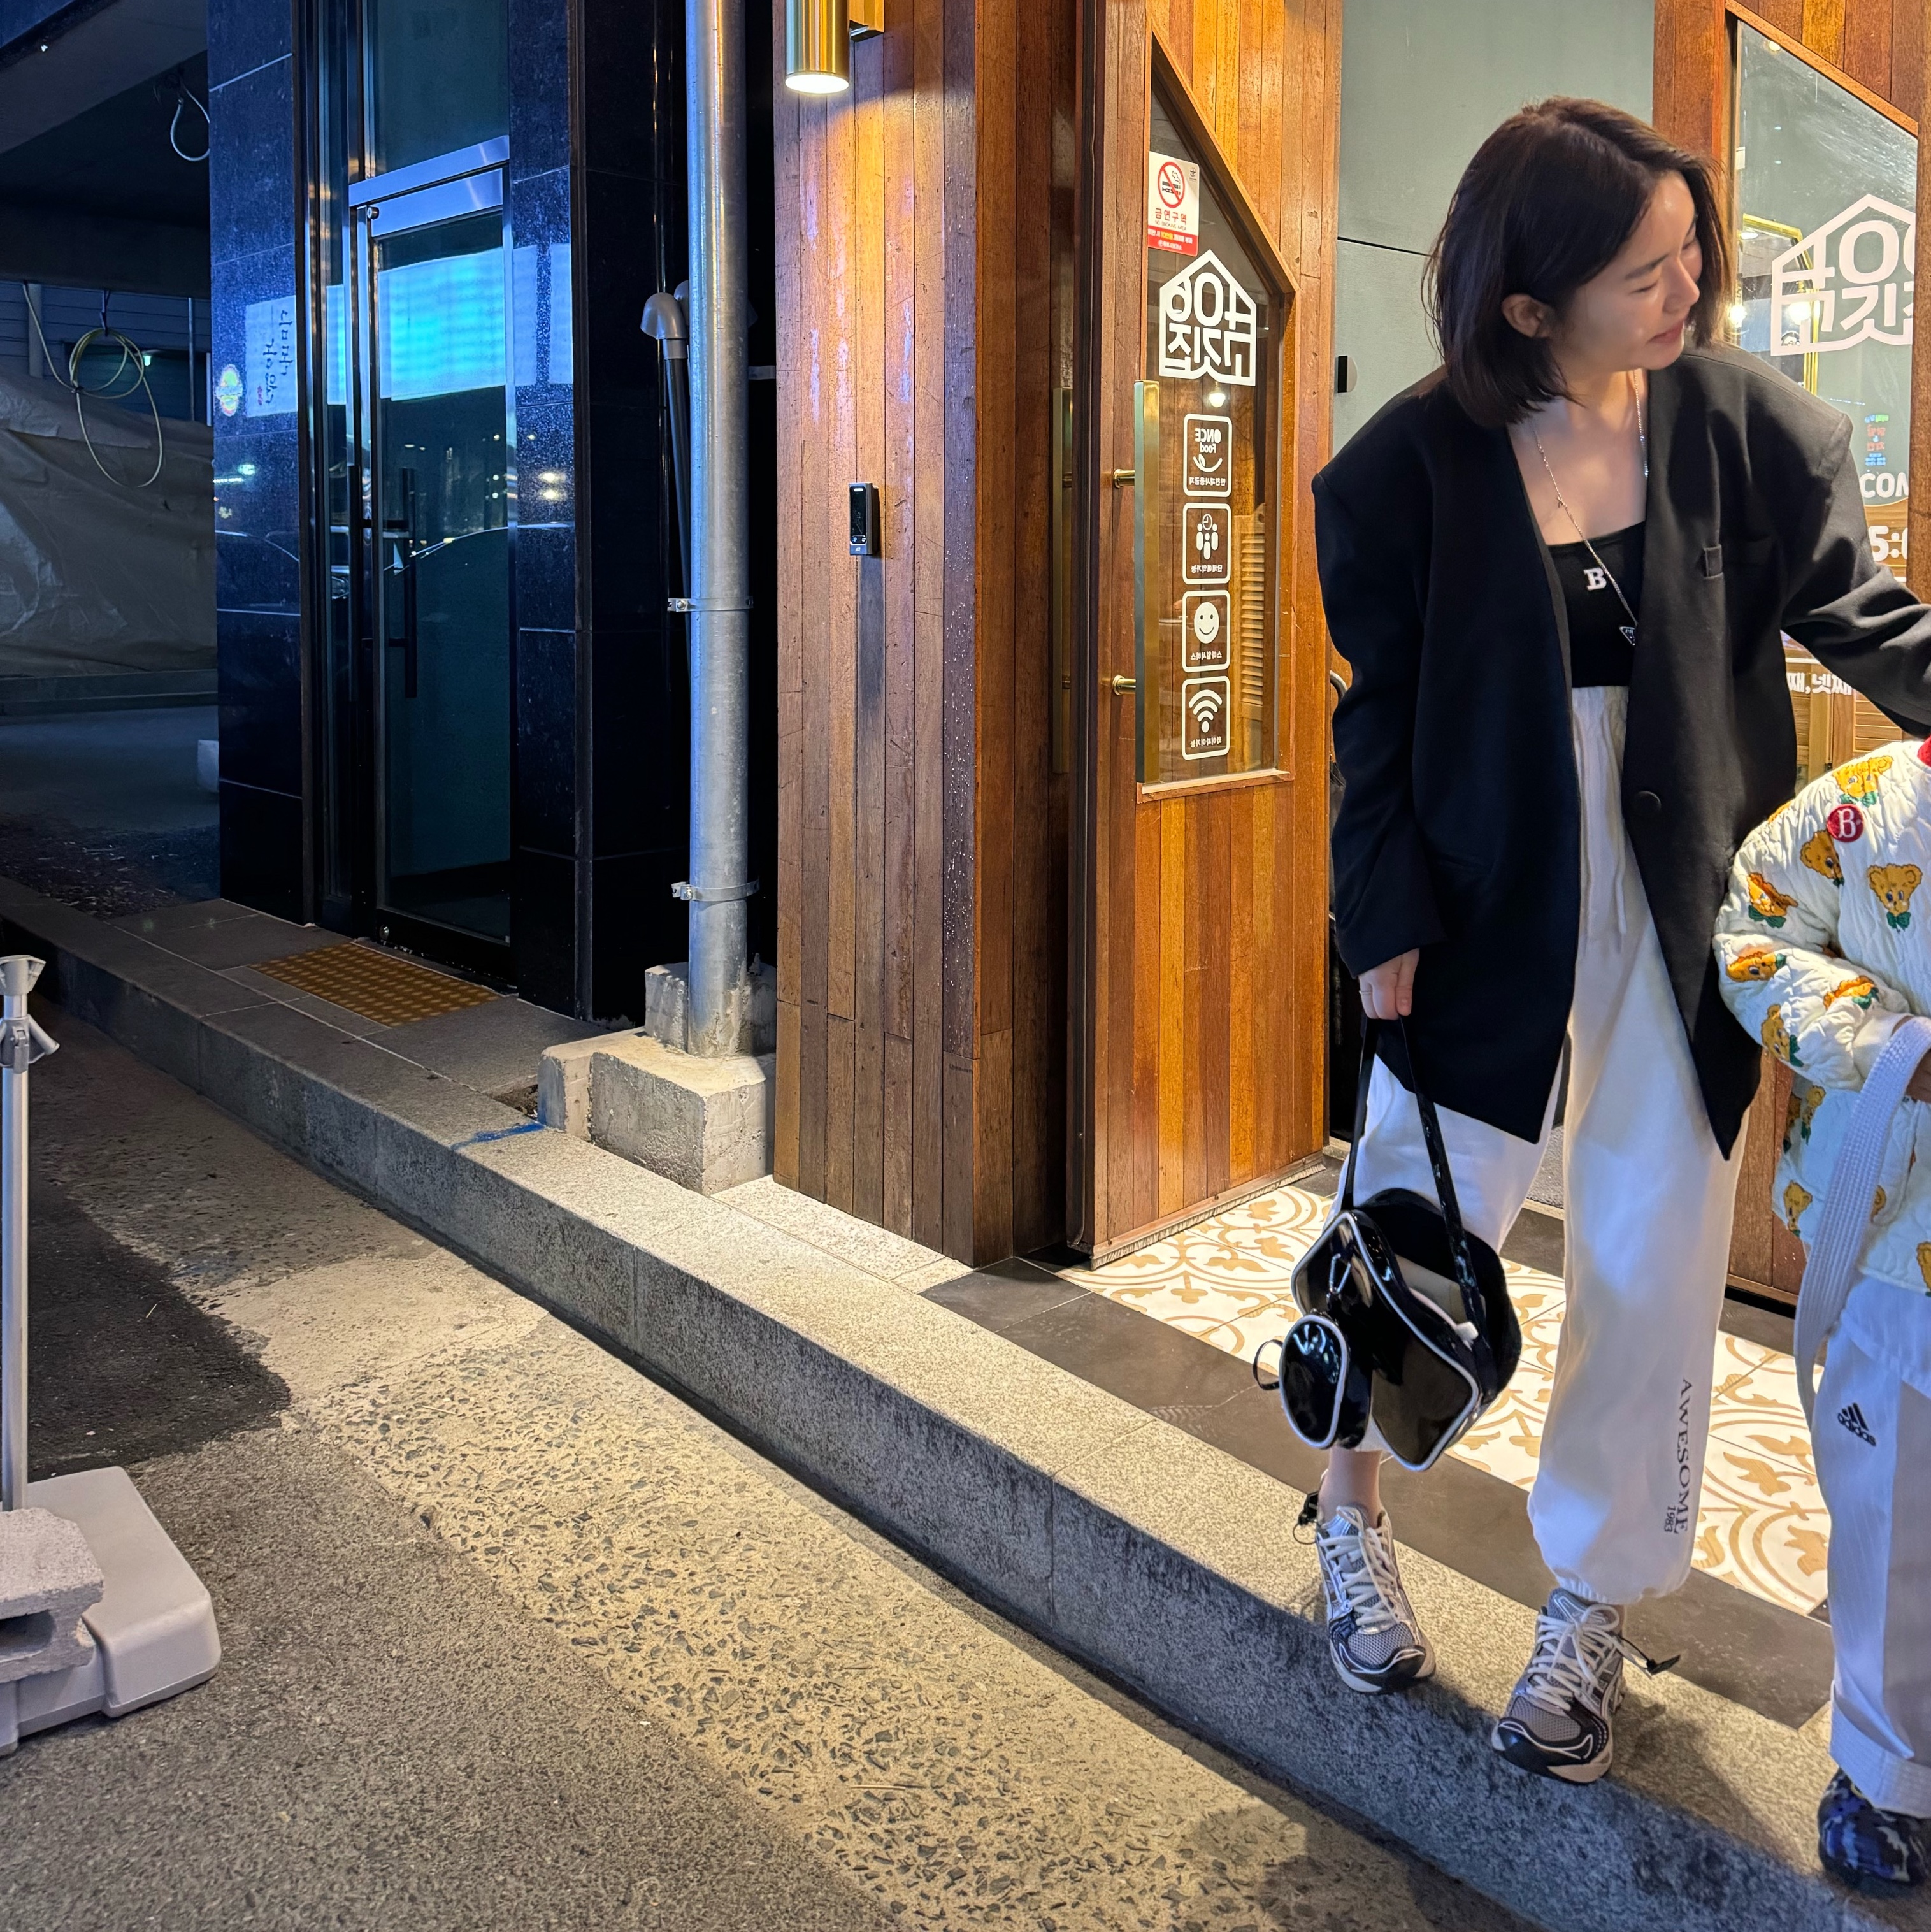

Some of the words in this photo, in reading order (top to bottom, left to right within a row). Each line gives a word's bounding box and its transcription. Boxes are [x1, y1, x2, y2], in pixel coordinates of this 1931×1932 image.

[1155, 208, 1186, 225] 금연구역
[1772, 220, 1915, 288] 40
[1771, 282, 1913, 356] 고기
[1583, 567, 1607, 591] B
[1837, 808, 1856, 838] B
[1837, 1413, 1876, 1446] adidas
[1674, 1378, 1693, 1534] AWESOME
[1664, 1505, 1676, 1532] 1983
